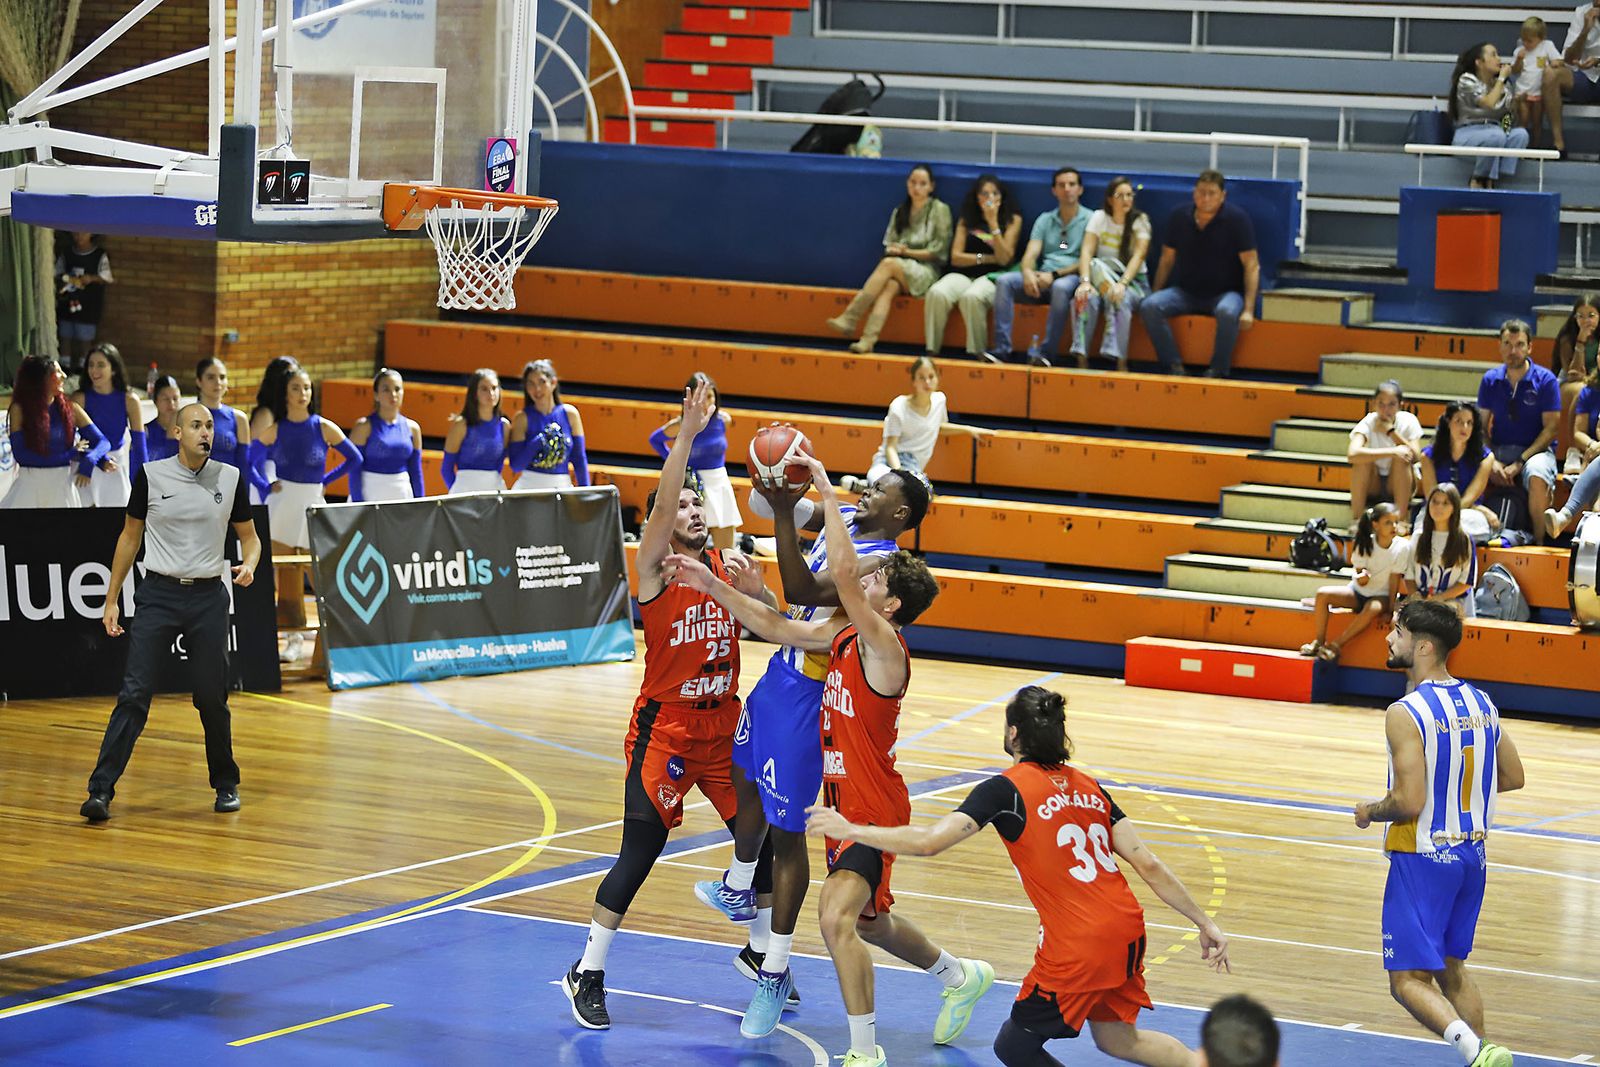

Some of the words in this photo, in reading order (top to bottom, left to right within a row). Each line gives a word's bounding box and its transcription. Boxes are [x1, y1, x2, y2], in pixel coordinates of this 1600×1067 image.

[492, 165, 510, 179] FINAL
[392, 548, 493, 590] viridis
[1244, 608, 1255, 626] 7
[412, 649, 427, 663] La
[532, 638, 568, 653] Huelva
[705, 639, 732, 662] 25
[1460, 744, 1475, 814] 1
[1037, 789, 1107, 821] GONÁLEZ
[1056, 822, 1120, 884] 30
